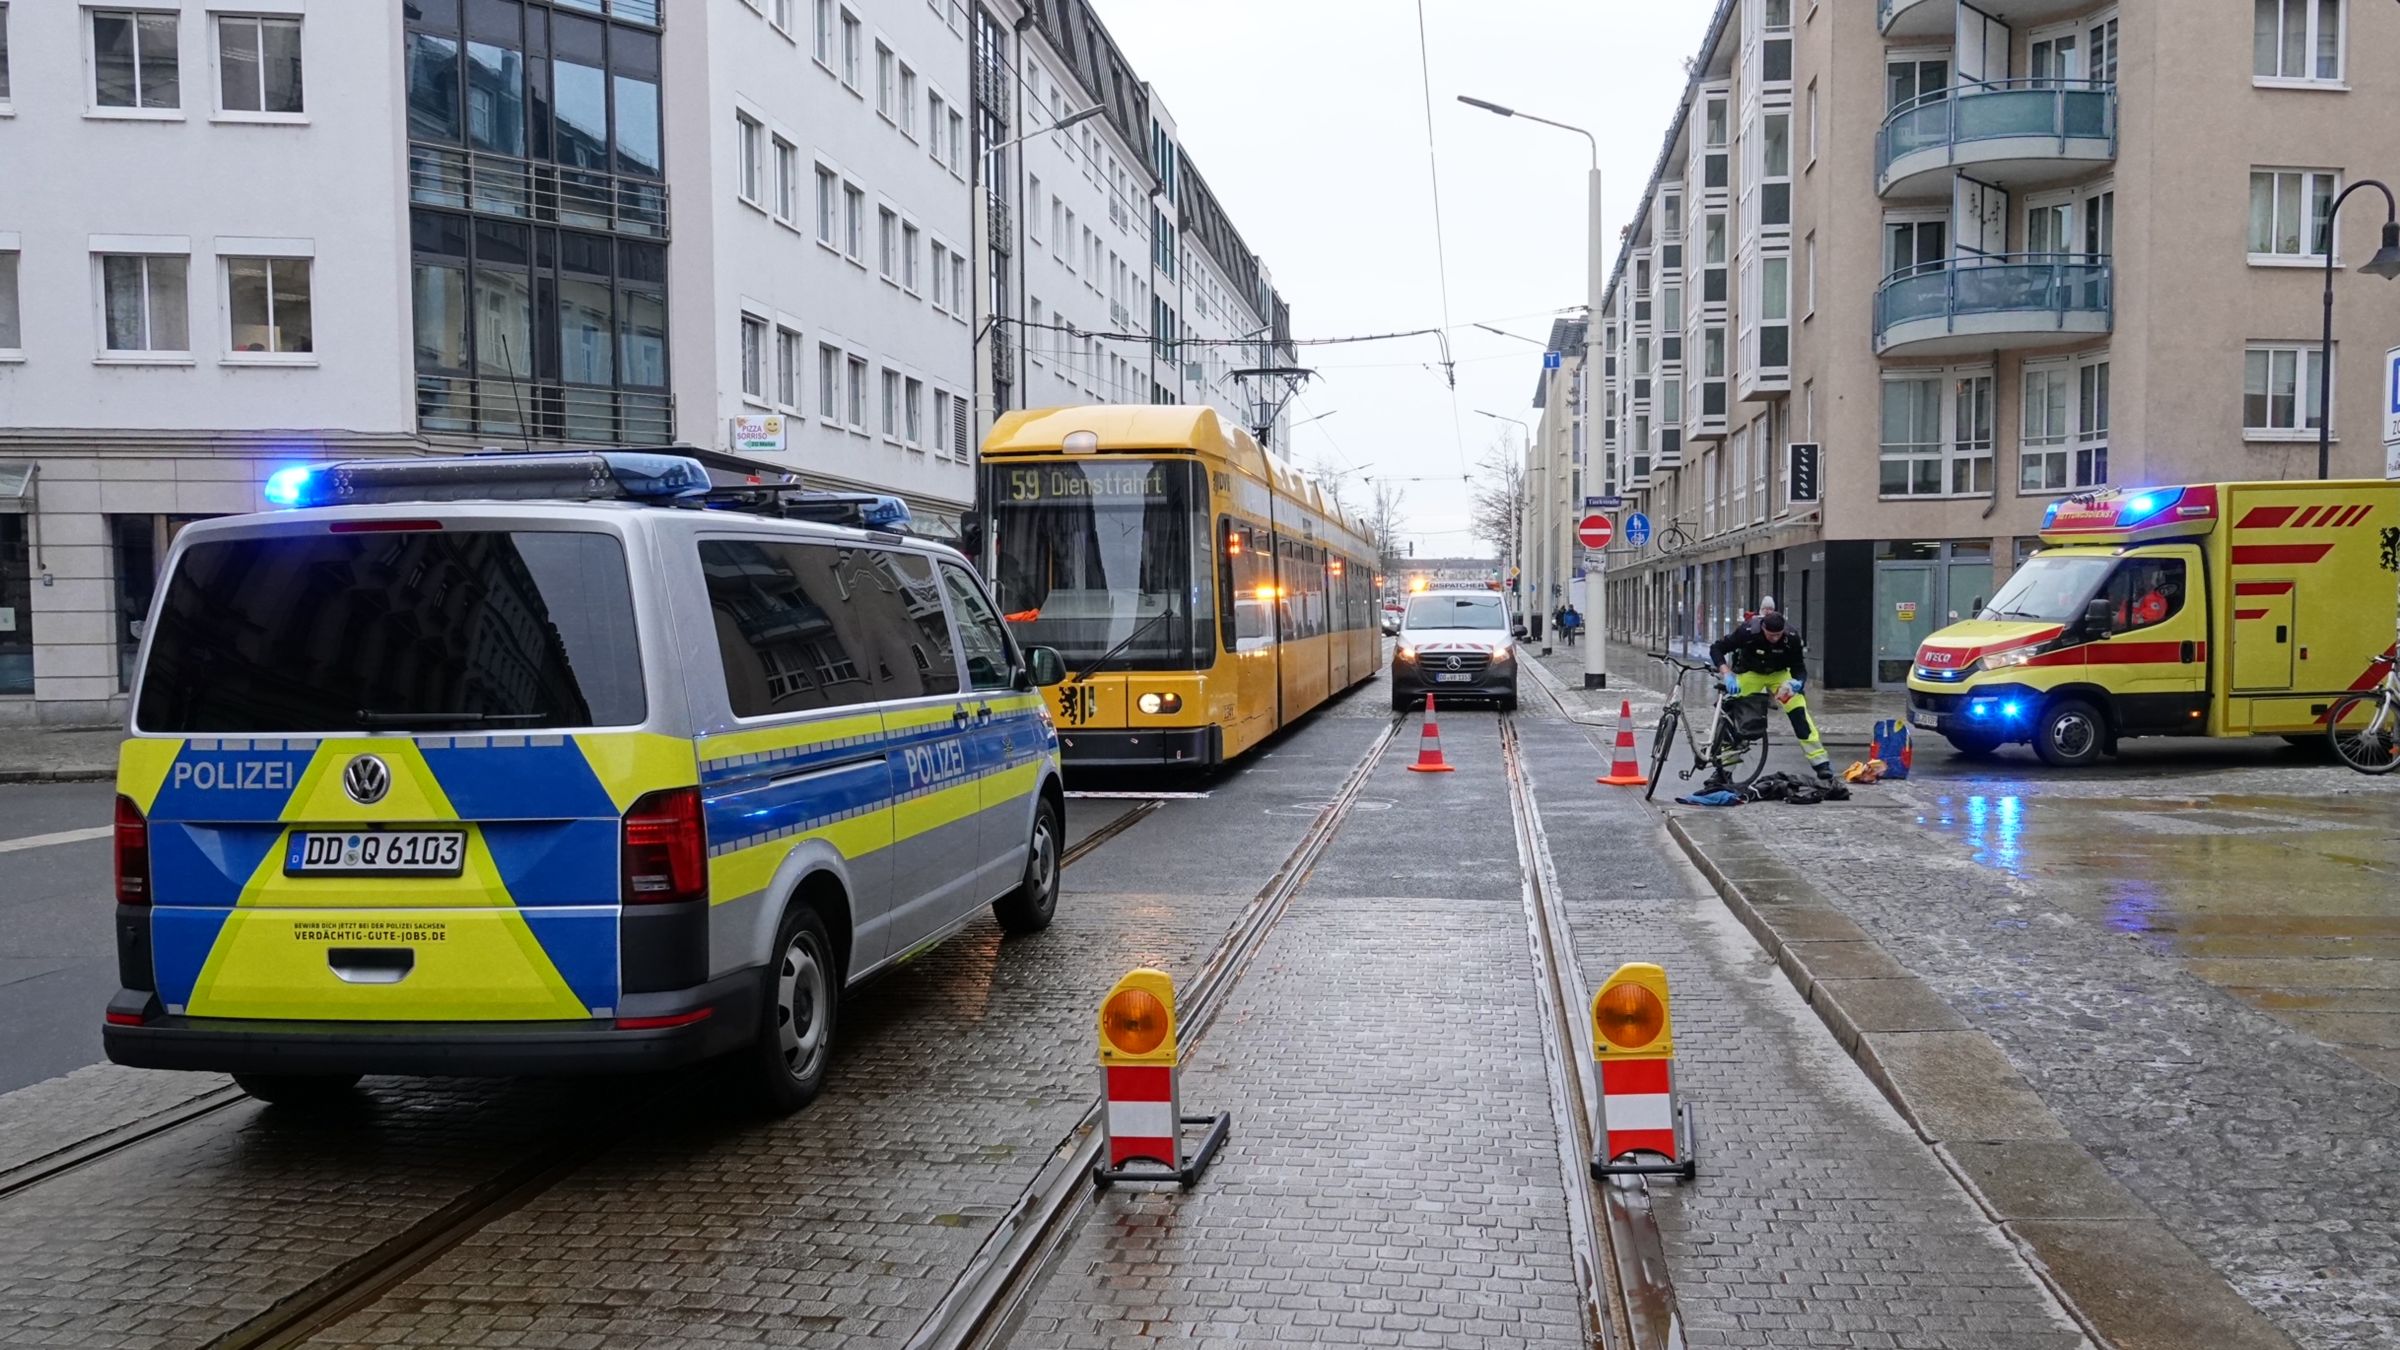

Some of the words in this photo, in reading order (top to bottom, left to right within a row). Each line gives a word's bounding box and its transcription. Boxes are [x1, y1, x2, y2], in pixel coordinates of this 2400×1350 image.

[737, 432, 768, 440] SORRISO
[1011, 470, 1040, 500] 59
[1051, 467, 1162, 496] Dienstfahrt
[1925, 651, 1952, 663] IVECO
[904, 738, 965, 788] POLIZEI
[174, 761, 293, 790] POLIZEI
[305, 837, 343, 865] DD
[361, 837, 380, 865] Q
[386, 837, 459, 865] 6103
[292, 855, 299, 863] D
[338, 922, 357, 930] JETZT
[294, 929, 446, 942] VERDÄCHTIG-GUTE-JOBS.DE
